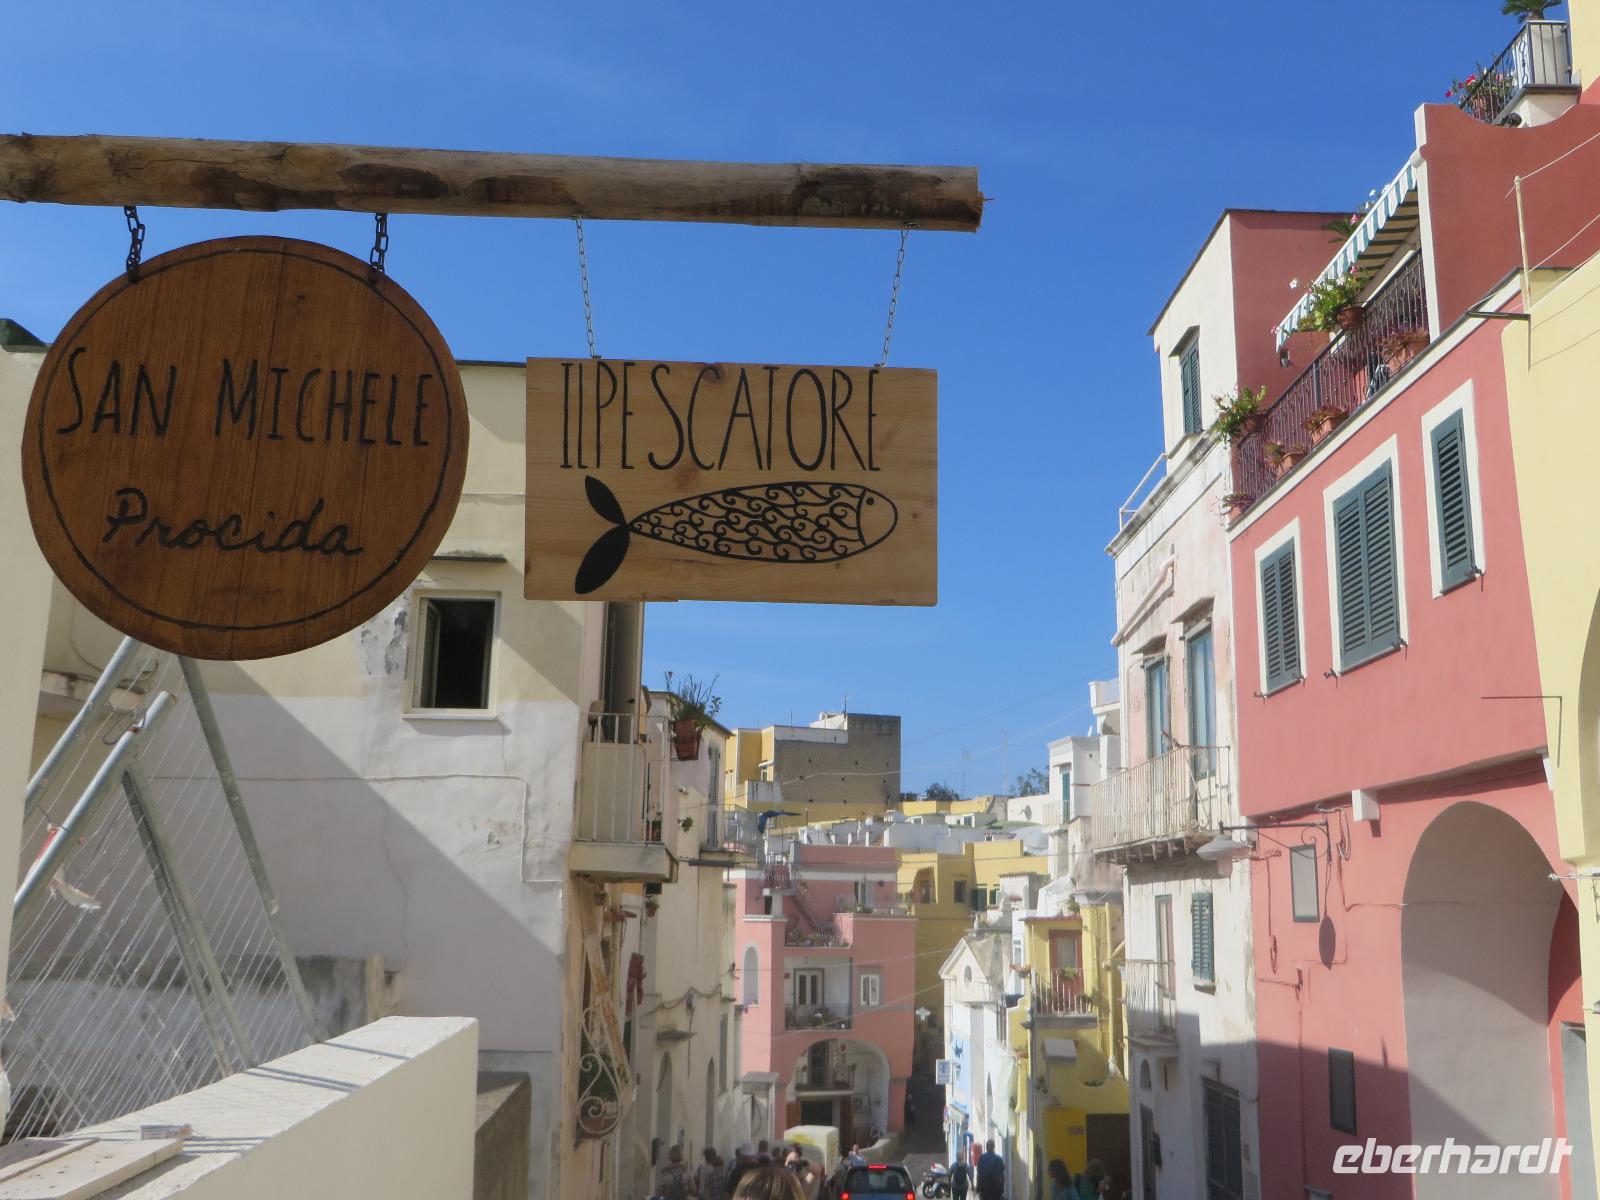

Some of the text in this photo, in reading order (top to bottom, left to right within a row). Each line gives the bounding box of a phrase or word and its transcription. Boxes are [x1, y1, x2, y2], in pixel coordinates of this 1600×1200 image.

[56, 346, 434, 447] SAN MICHELE
[102, 487, 364, 556] Procida
